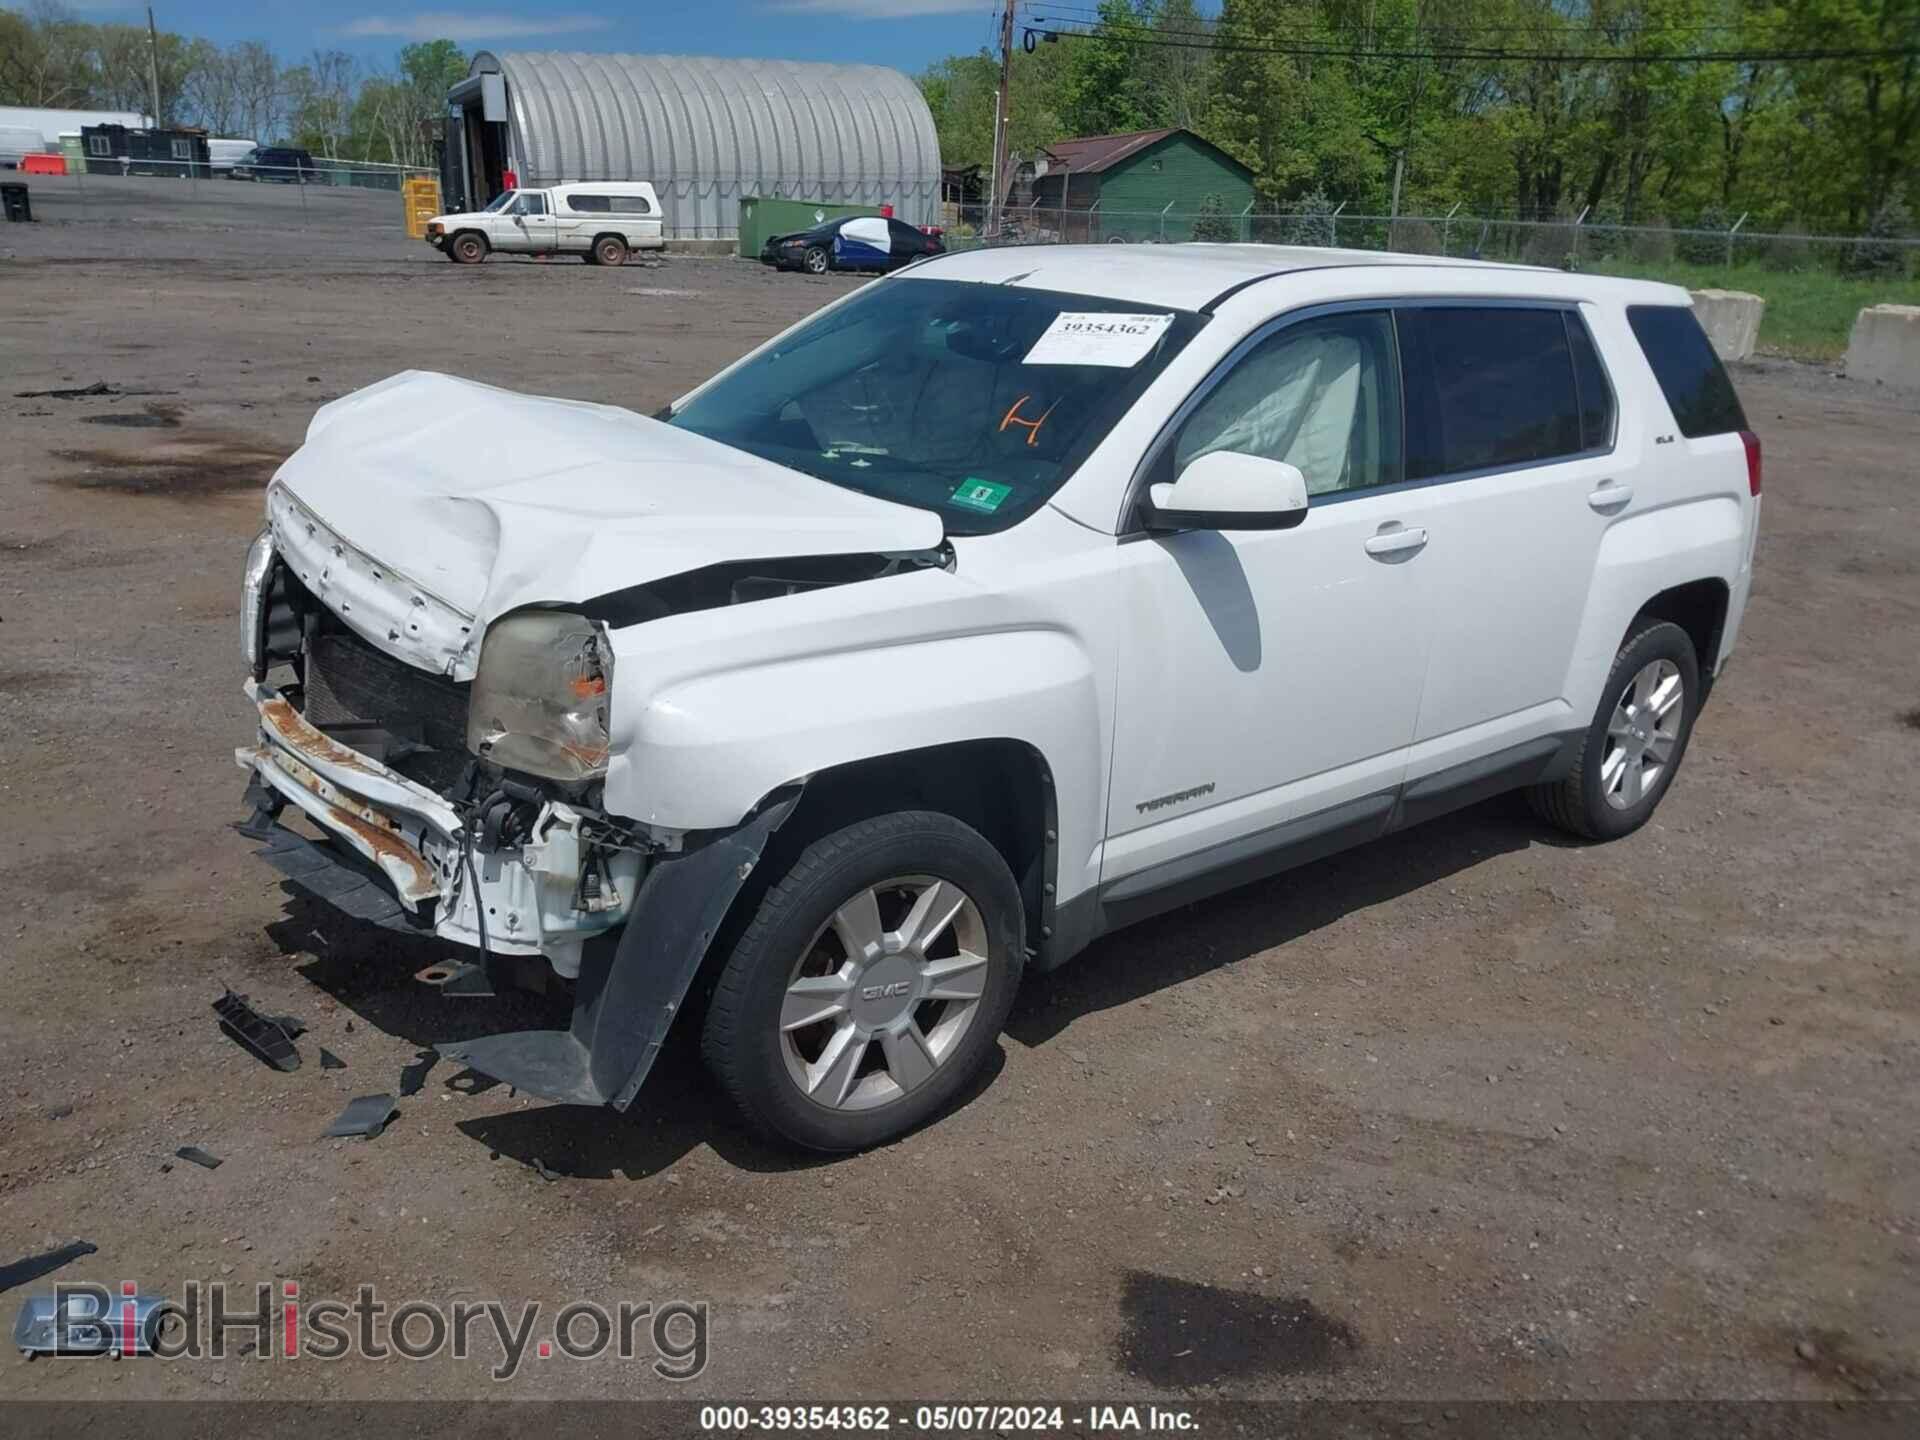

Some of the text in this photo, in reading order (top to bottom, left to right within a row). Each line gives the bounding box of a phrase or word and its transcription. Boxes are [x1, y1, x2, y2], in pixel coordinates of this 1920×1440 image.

[1061, 322, 1151, 336] 39354362
[999, 396, 1063, 446] H
[1136, 782, 1216, 814] TERRAIN
[863, 981, 912, 1001] GMC
